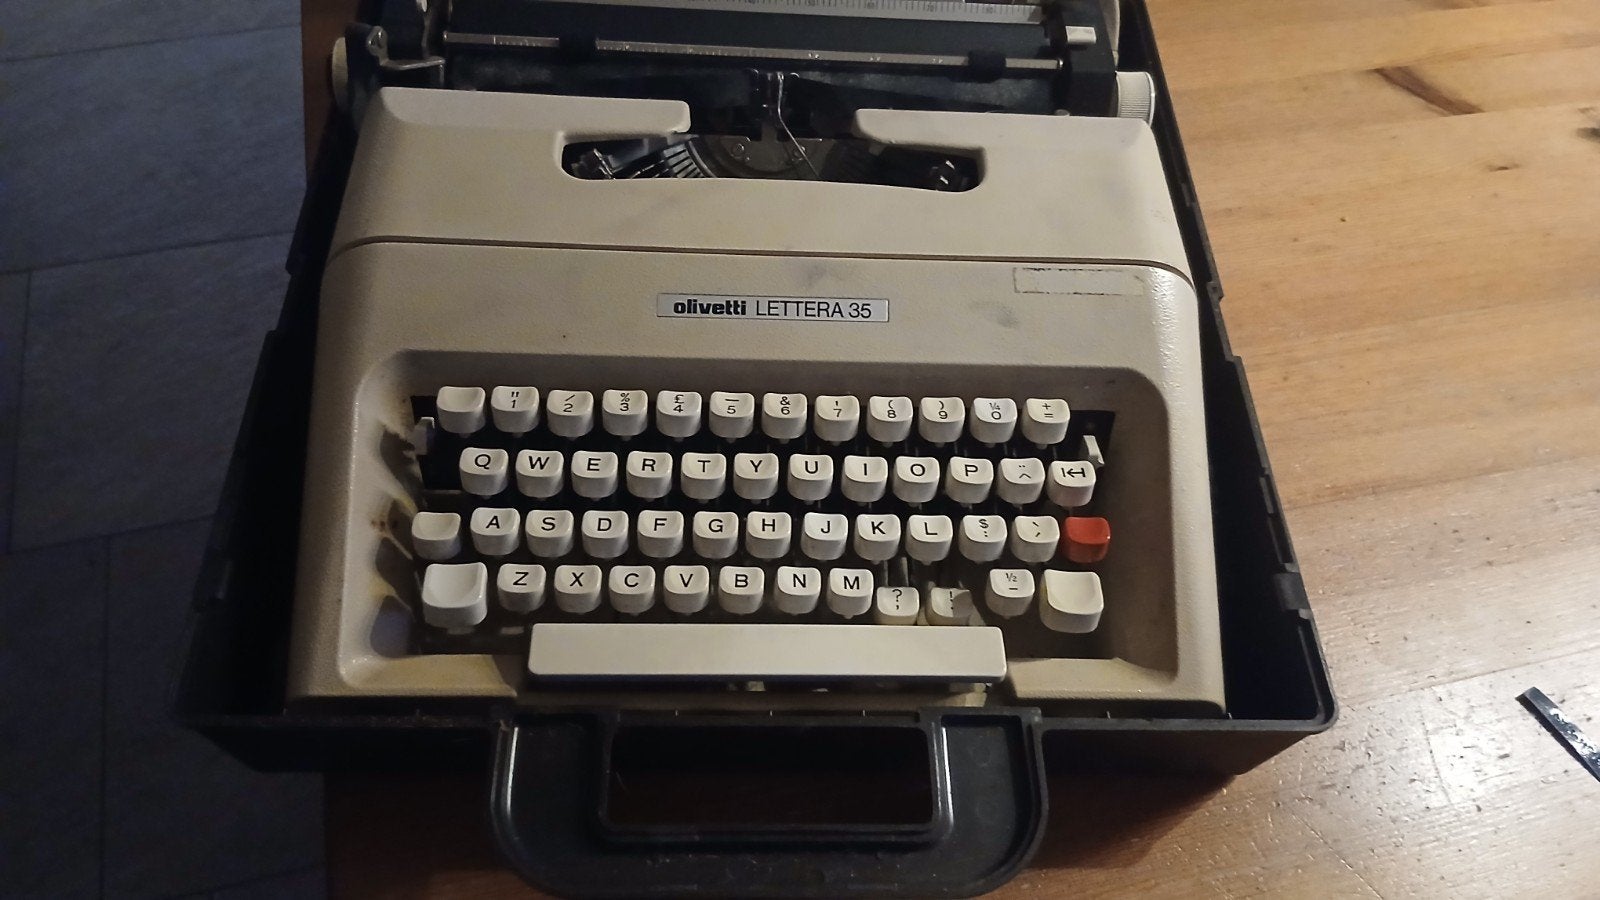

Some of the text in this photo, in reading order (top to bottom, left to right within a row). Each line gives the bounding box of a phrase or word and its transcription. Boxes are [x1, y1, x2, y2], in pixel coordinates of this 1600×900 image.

[673, 298, 872, 319] olivetti LETTERA 35
[620, 392, 631, 402] %
[673, 393, 685, 405] £
[780, 395, 792, 407] &
[511, 399, 517, 409] 1
[562, 403, 574, 413] 2
[619, 402, 630, 412] 3
[673, 404, 684, 413] 4
[726, 405, 736, 415] 5
[1042, 402, 1052, 411] +
[780, 406, 790, 416] 6
[833, 408, 842, 418] 7
[887, 409, 897, 419] 8
[938, 410, 948, 420] 9
[475, 454, 491, 470] Q
[529, 456, 550, 470] W
[587, 458, 601, 471] E
[642, 458, 656, 472] R
[697, 460, 711, 472] T
[750, 460, 762, 473] Y
[805, 461, 818, 474] U
[864, 463, 867, 476] I
[910, 464, 925, 476] O
[965, 464, 978, 477] P
[486, 516, 500, 529] A
[541, 517, 556, 531] S
[597, 518, 612, 531] D
[654, 518, 667, 531] F
[709, 519, 723, 532] G
[762, 518, 775, 532] H
[821, 521, 830, 533] J
[871, 521, 886, 534] K
[924, 522, 938, 535] L
[978, 518, 989, 529] $
[513, 572, 529, 586] Z
[570, 572, 584, 587] X
[624, 573, 639, 587] C
[680, 574, 693, 587] V
[735, 574, 748, 588] B
[793, 574, 806, 588] N
[844, 576, 860, 590] M
[891, 588, 903, 603] ?
